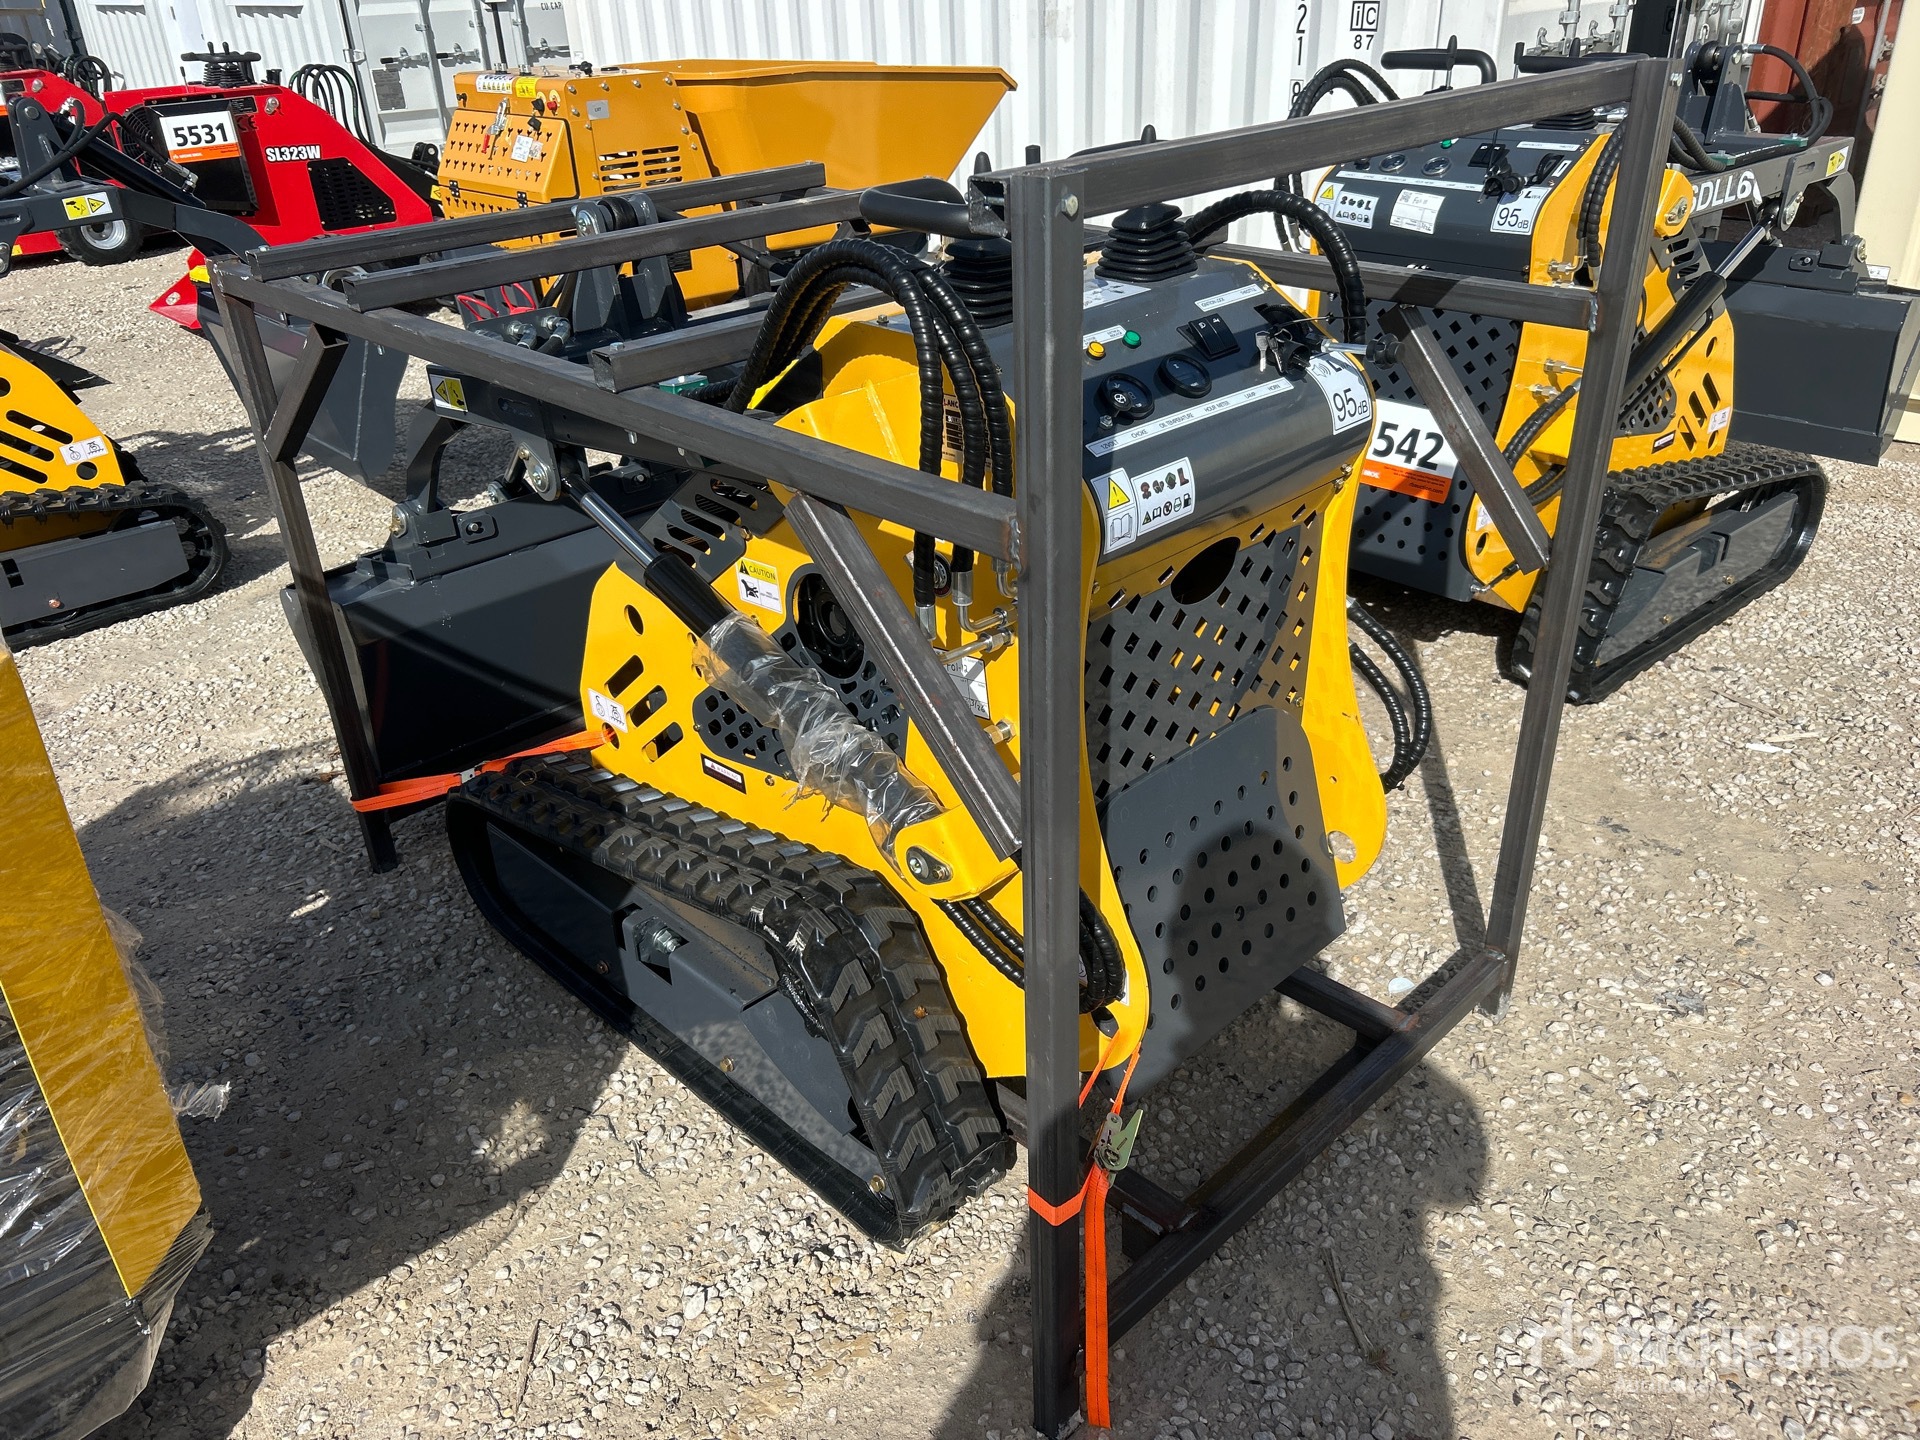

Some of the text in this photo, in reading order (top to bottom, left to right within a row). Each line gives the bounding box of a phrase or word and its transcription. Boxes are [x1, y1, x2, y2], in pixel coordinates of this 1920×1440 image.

[1353, 34, 1375, 51] 87
[173, 122, 229, 147] 5531
[265, 145, 321, 162] SL323W
[1131, 428, 1149, 439] CHOKE
[1166, 412, 1195, 427] TEMPERATURE
[1203, 404, 1217, 413] HOUR
[1216, 400, 1231, 409] METER
[1244, 391, 1256, 400] LAMP
[1267, 383, 1281, 392] HORN
[1371, 420, 1445, 472] 542
[748, 565, 776, 581] CAUTION
